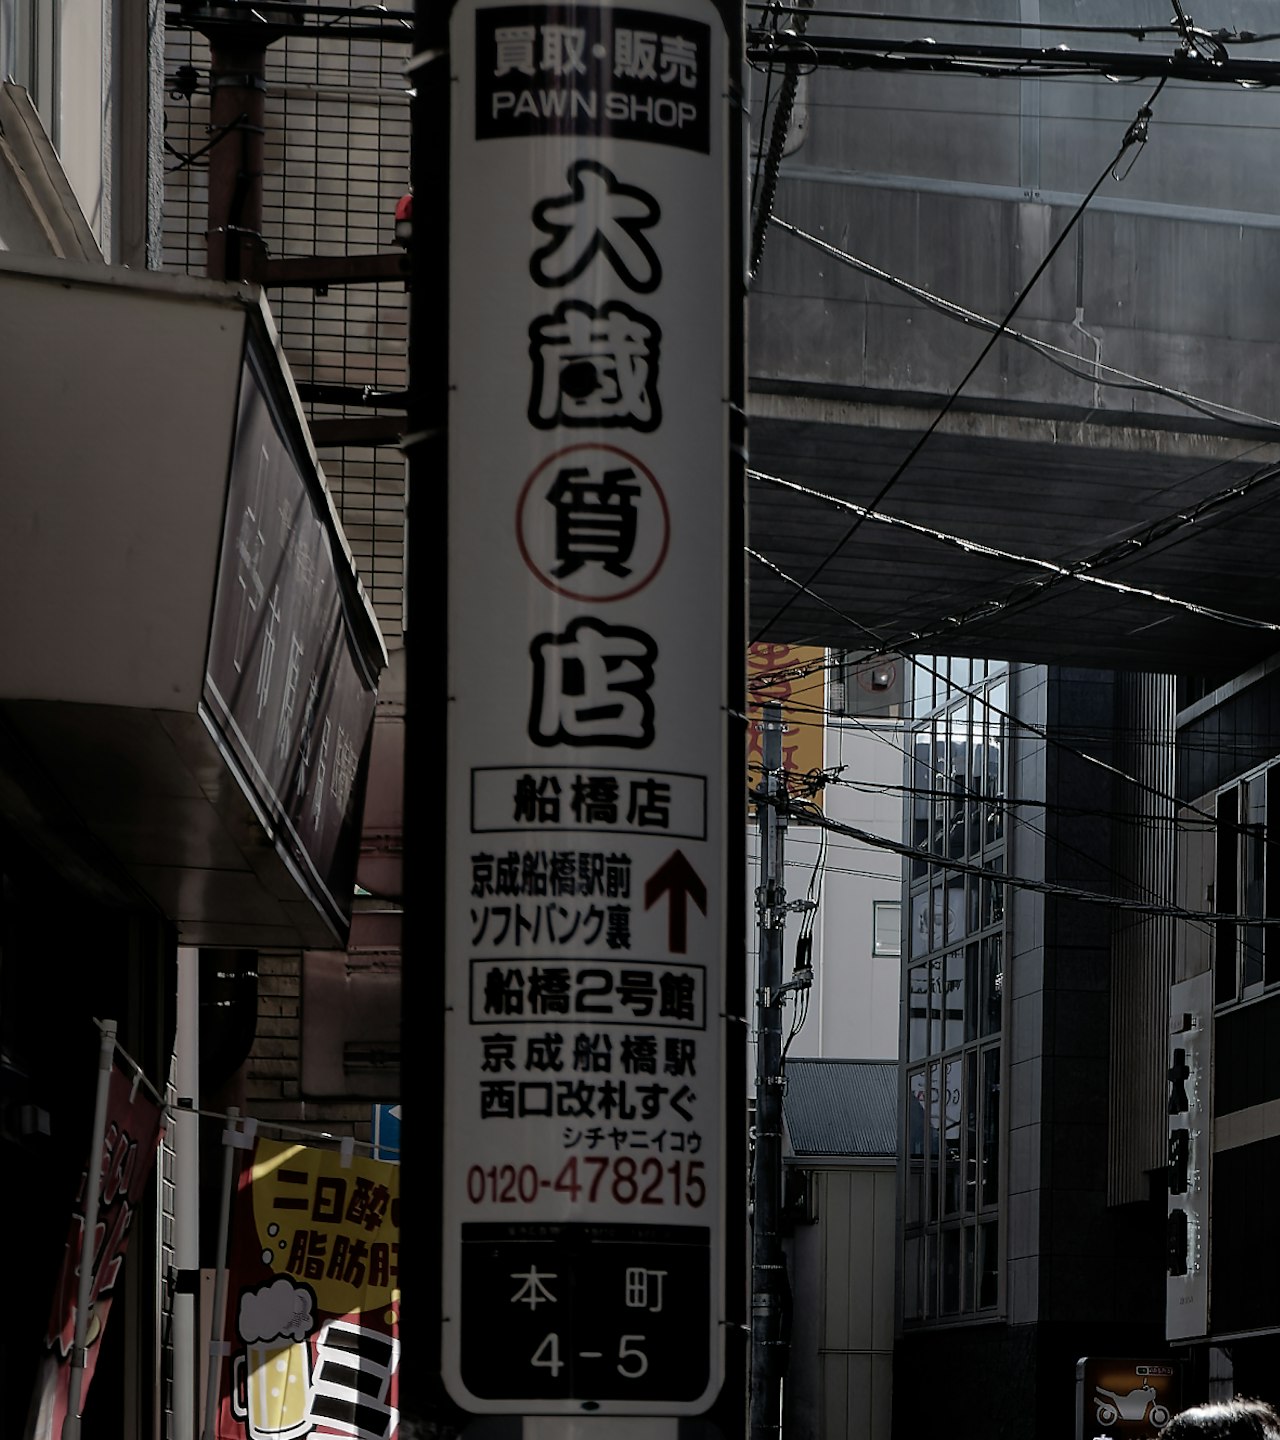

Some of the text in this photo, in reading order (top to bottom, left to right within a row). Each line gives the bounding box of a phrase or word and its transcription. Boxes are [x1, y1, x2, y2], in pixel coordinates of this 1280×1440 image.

[493, 25, 698, 90] 買取・販売
[491, 89, 698, 130] PAWN SHOP
[528, 159, 662, 749] 大蔵質店
[513, 774, 672, 828] 船橋店
[470, 852, 632, 898] 京成船橋駅前
[470, 903, 632, 950] ソフトバンク裏
[484, 966, 695, 1021] 船橋2号館
[480, 1033, 697, 1077] 京成船橋駅
[479, 1080, 698, 1122] 西口改札すぐ
[562, 1126, 703, 1154] シチヤニイコウ
[466, 1155, 706, 1208] 0120-478215
[509, 1263, 669, 1314] 本町
[529, 1331, 649, 1380] 4-5
